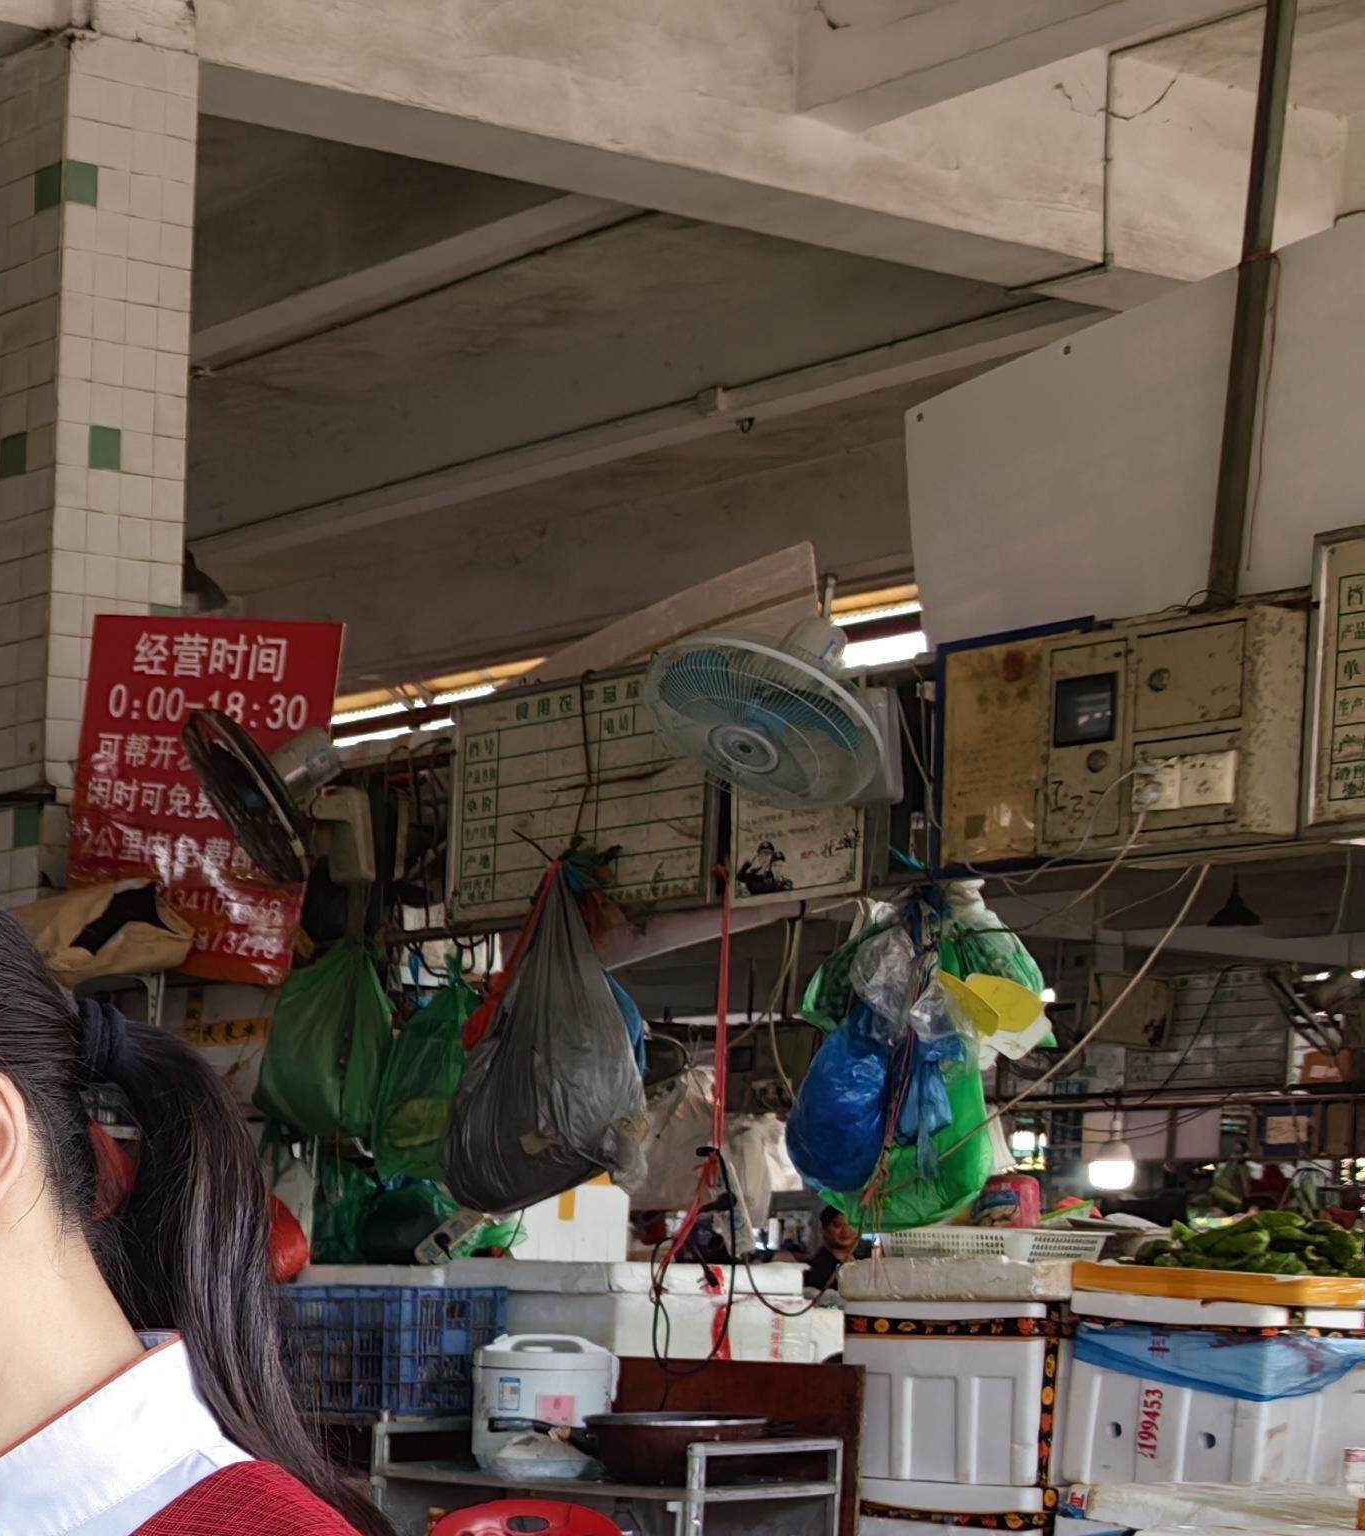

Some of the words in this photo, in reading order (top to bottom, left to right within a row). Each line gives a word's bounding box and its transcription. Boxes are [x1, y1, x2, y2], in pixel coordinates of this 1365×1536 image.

[132, 632, 288, 683] 经营时间
[97, 732, 193, 772] 可帮开
